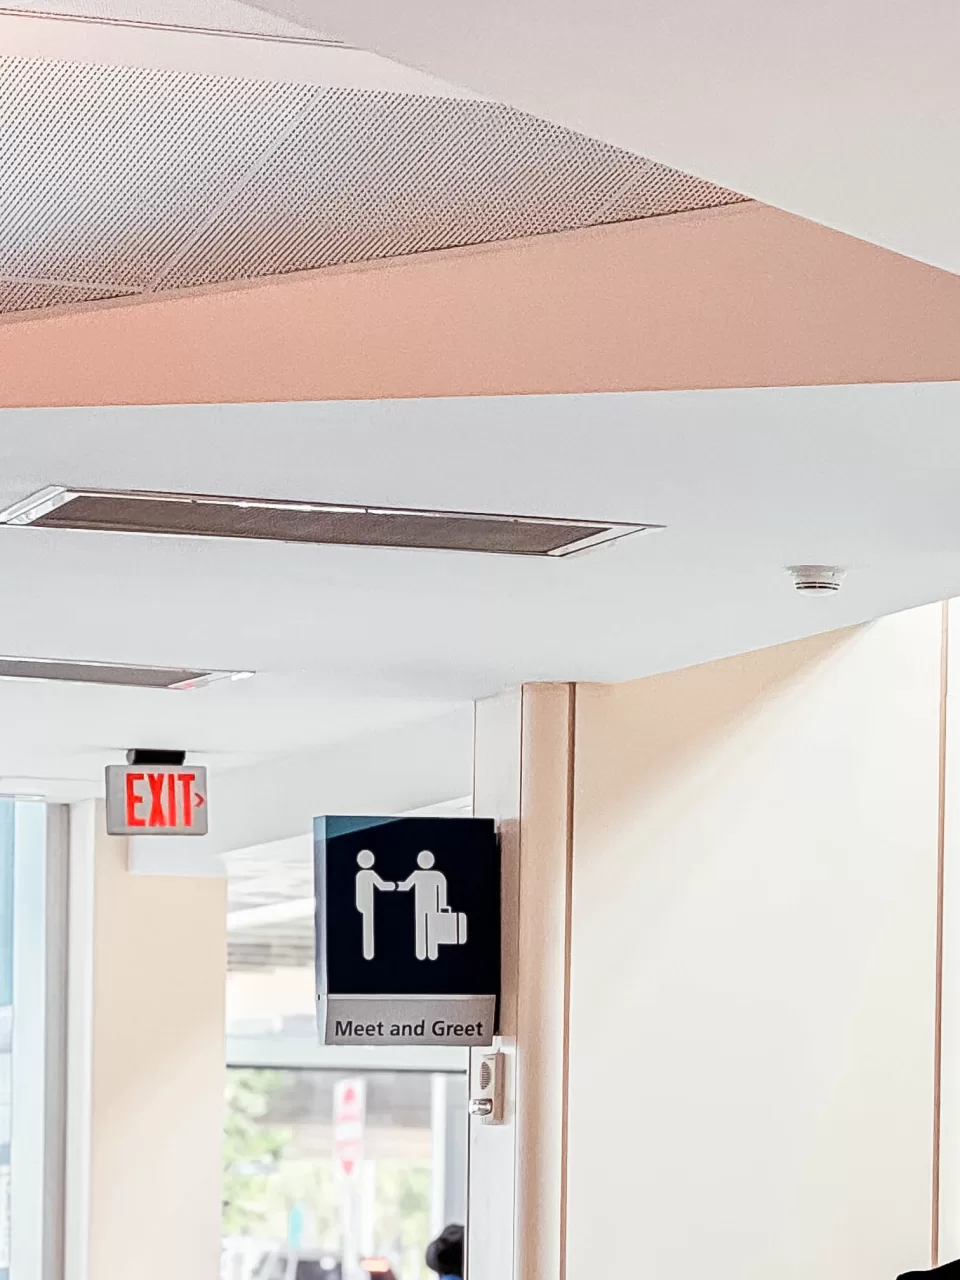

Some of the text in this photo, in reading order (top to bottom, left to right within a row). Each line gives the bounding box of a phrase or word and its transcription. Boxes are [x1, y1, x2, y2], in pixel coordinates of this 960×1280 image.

[126, 773, 195, 827] EXIT
[335, 1019, 483, 1036] Meet and Greet
